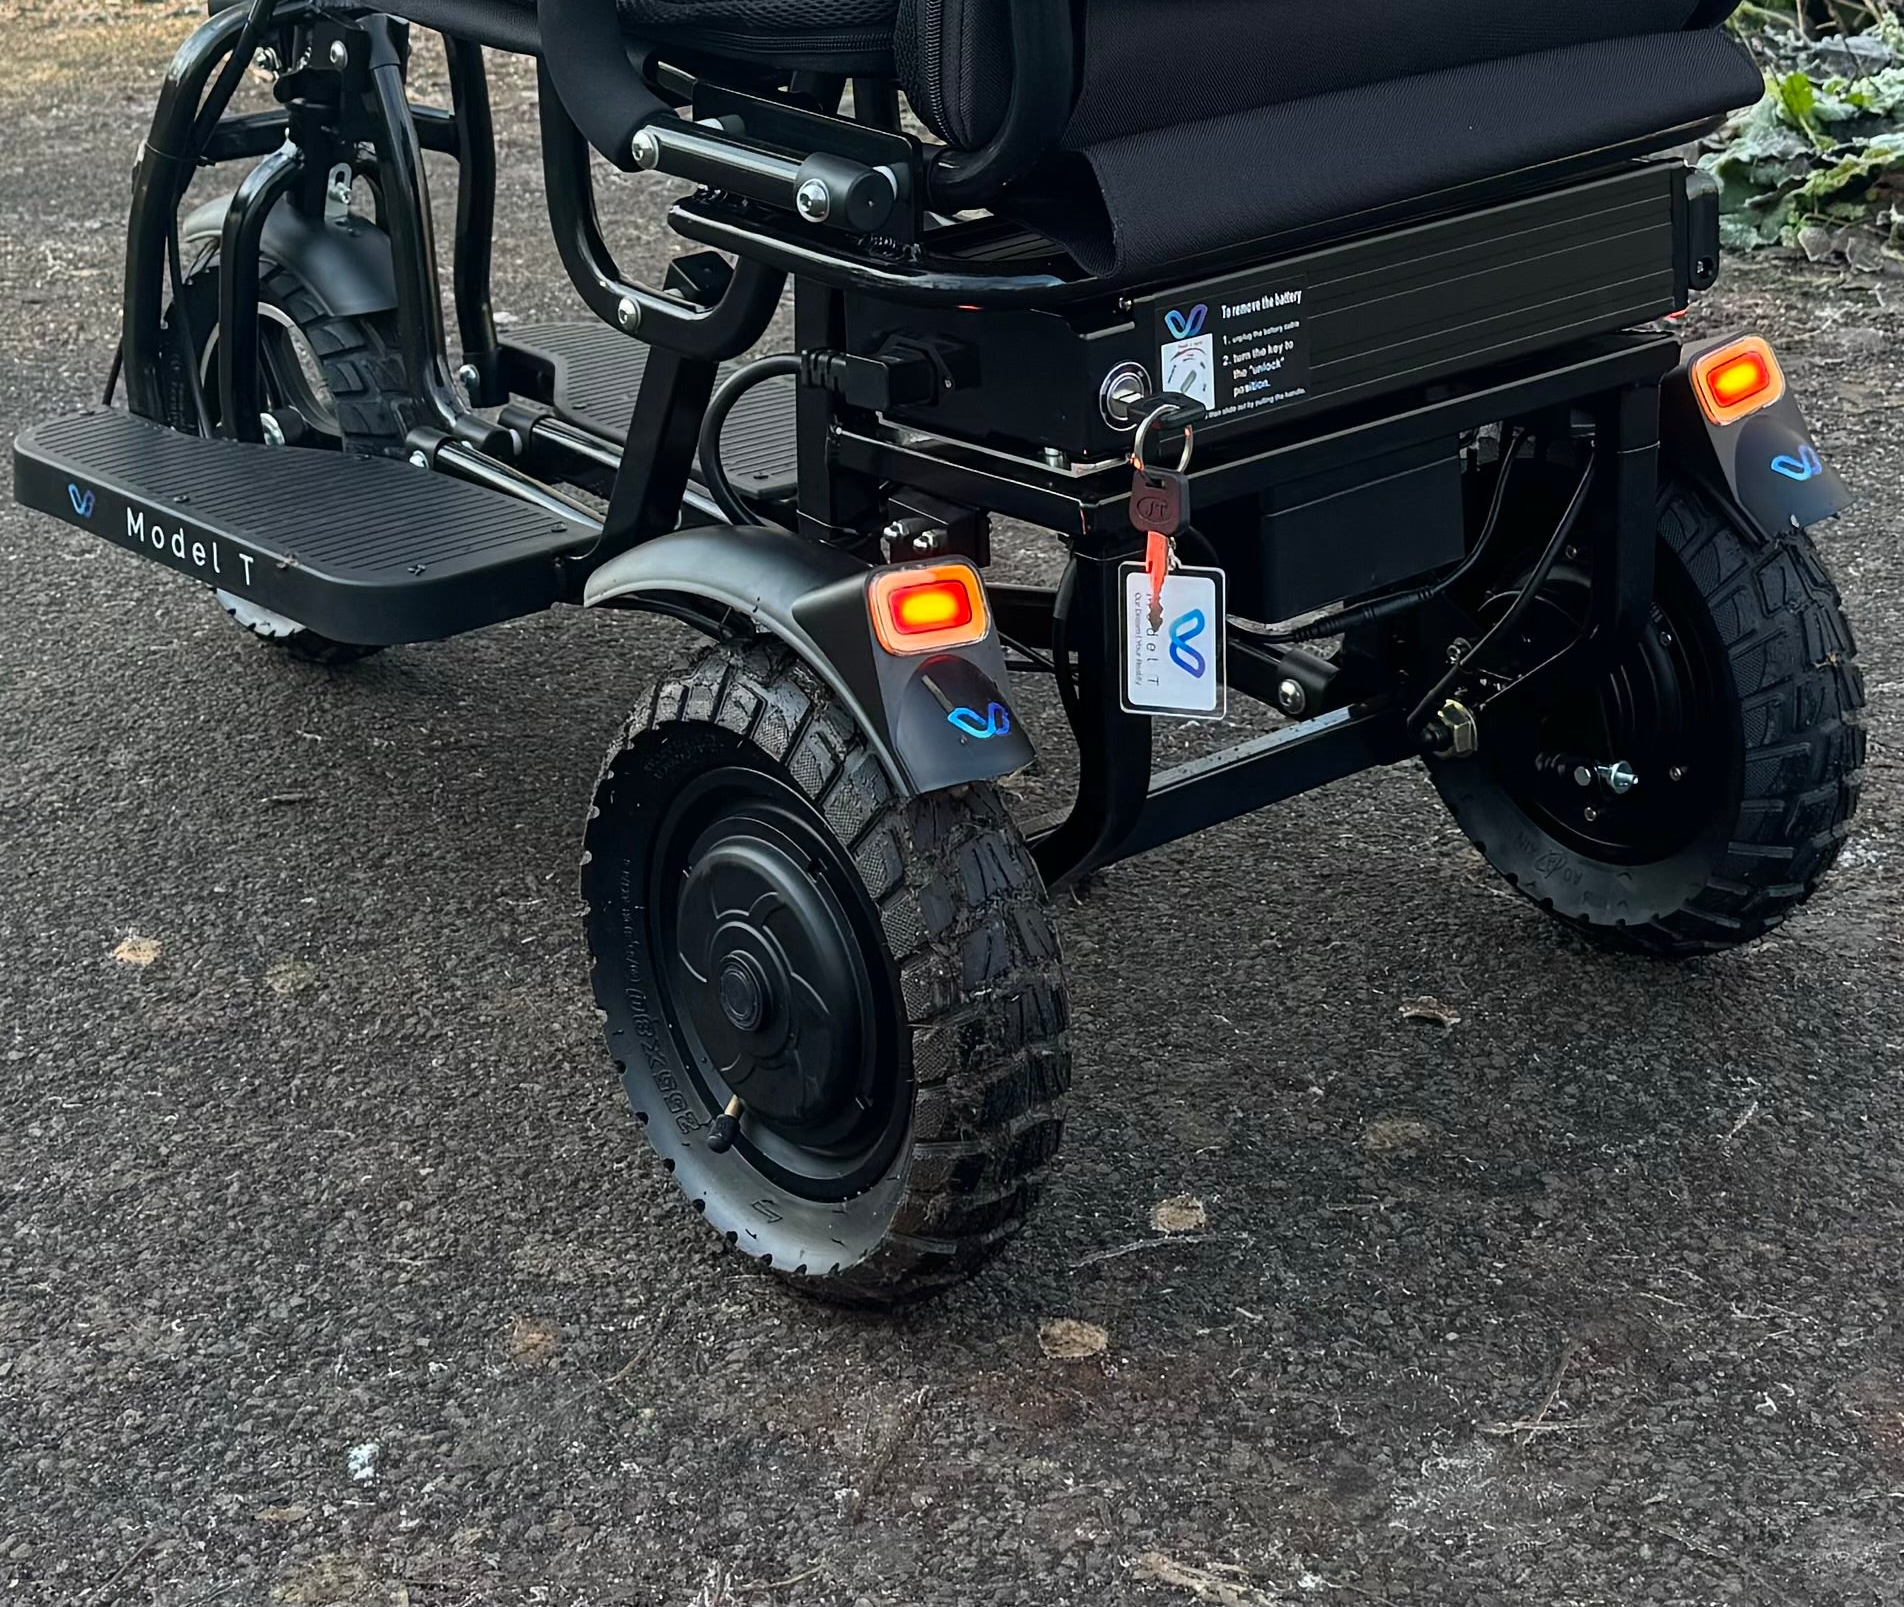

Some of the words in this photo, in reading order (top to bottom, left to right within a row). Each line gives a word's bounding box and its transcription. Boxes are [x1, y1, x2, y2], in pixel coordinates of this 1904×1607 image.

[1221, 305, 1231, 319] To
[1232, 300, 1261, 317] remove
[1261, 295, 1274, 309] the
[1274, 290, 1302, 307] battery
[1223, 335, 1231, 345] 1.
[1222, 355, 1232, 366] 2.
[1233, 352, 1251, 363] turn
[1252, 347, 1267, 358] the
[1267, 343, 1283, 355] key
[1284, 340, 1294, 350] to
[1233, 368, 1248, 379] the
[1233, 379, 1271, 398] position.
[125, 505, 222, 575] Model
[239, 552, 255, 587] T
[1146, 593, 1159, 661] del
[1147, 676, 1160, 687] T
